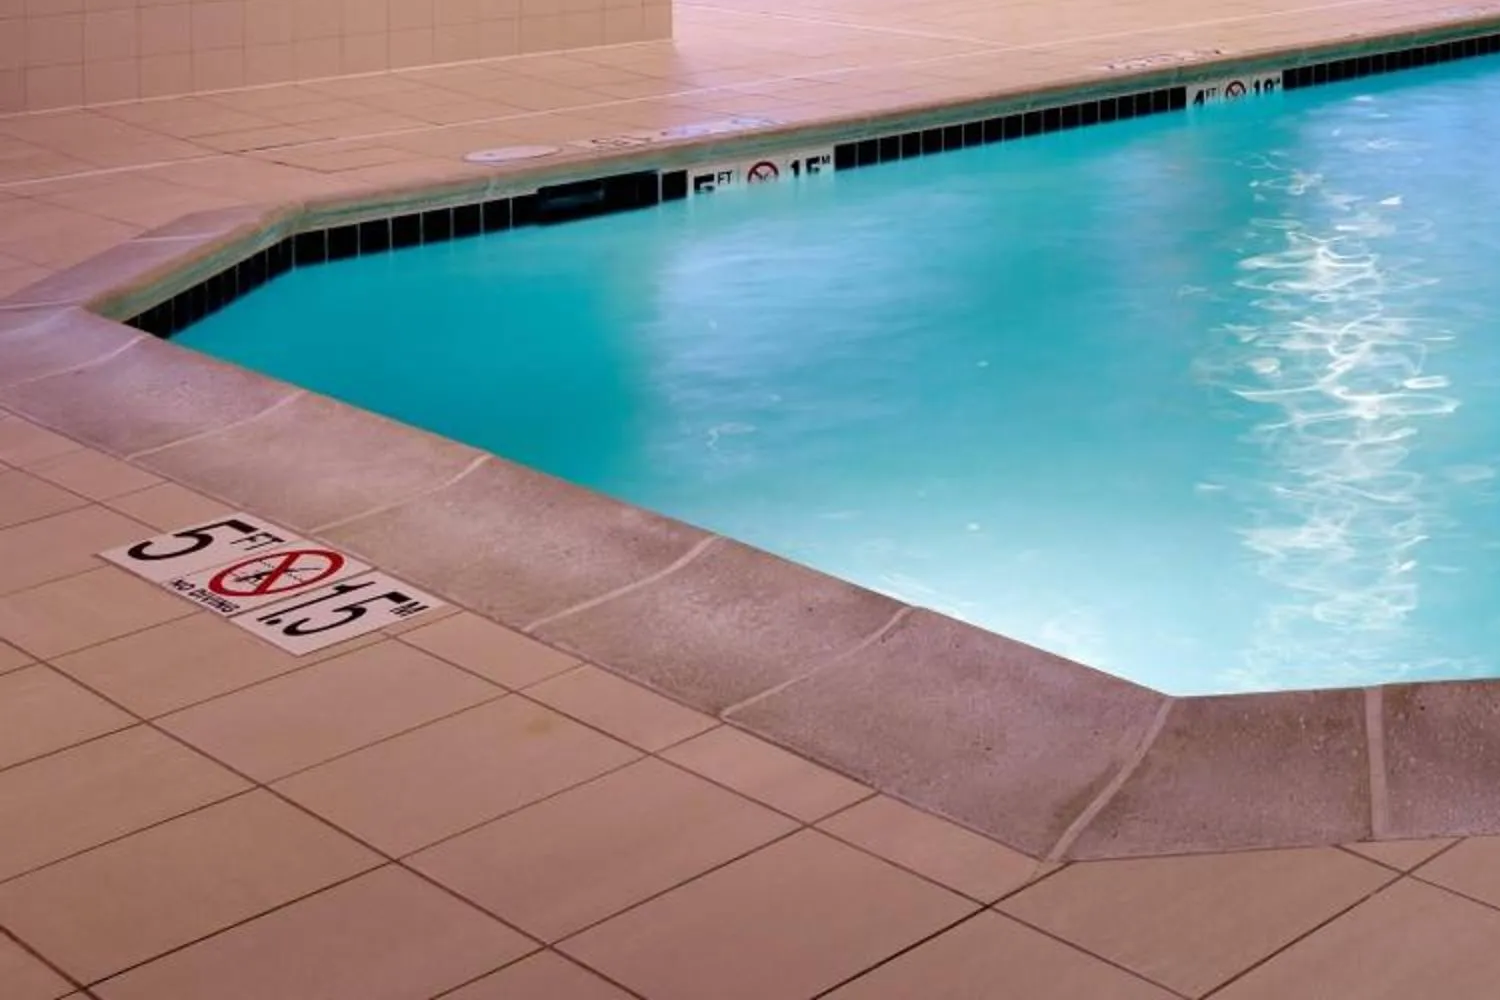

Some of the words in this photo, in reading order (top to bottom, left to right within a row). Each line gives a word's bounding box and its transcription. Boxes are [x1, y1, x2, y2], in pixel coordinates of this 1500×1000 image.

[127, 518, 260, 561] 5
[171, 578, 196, 592] NO
[188, 587, 241, 614] DIVING
